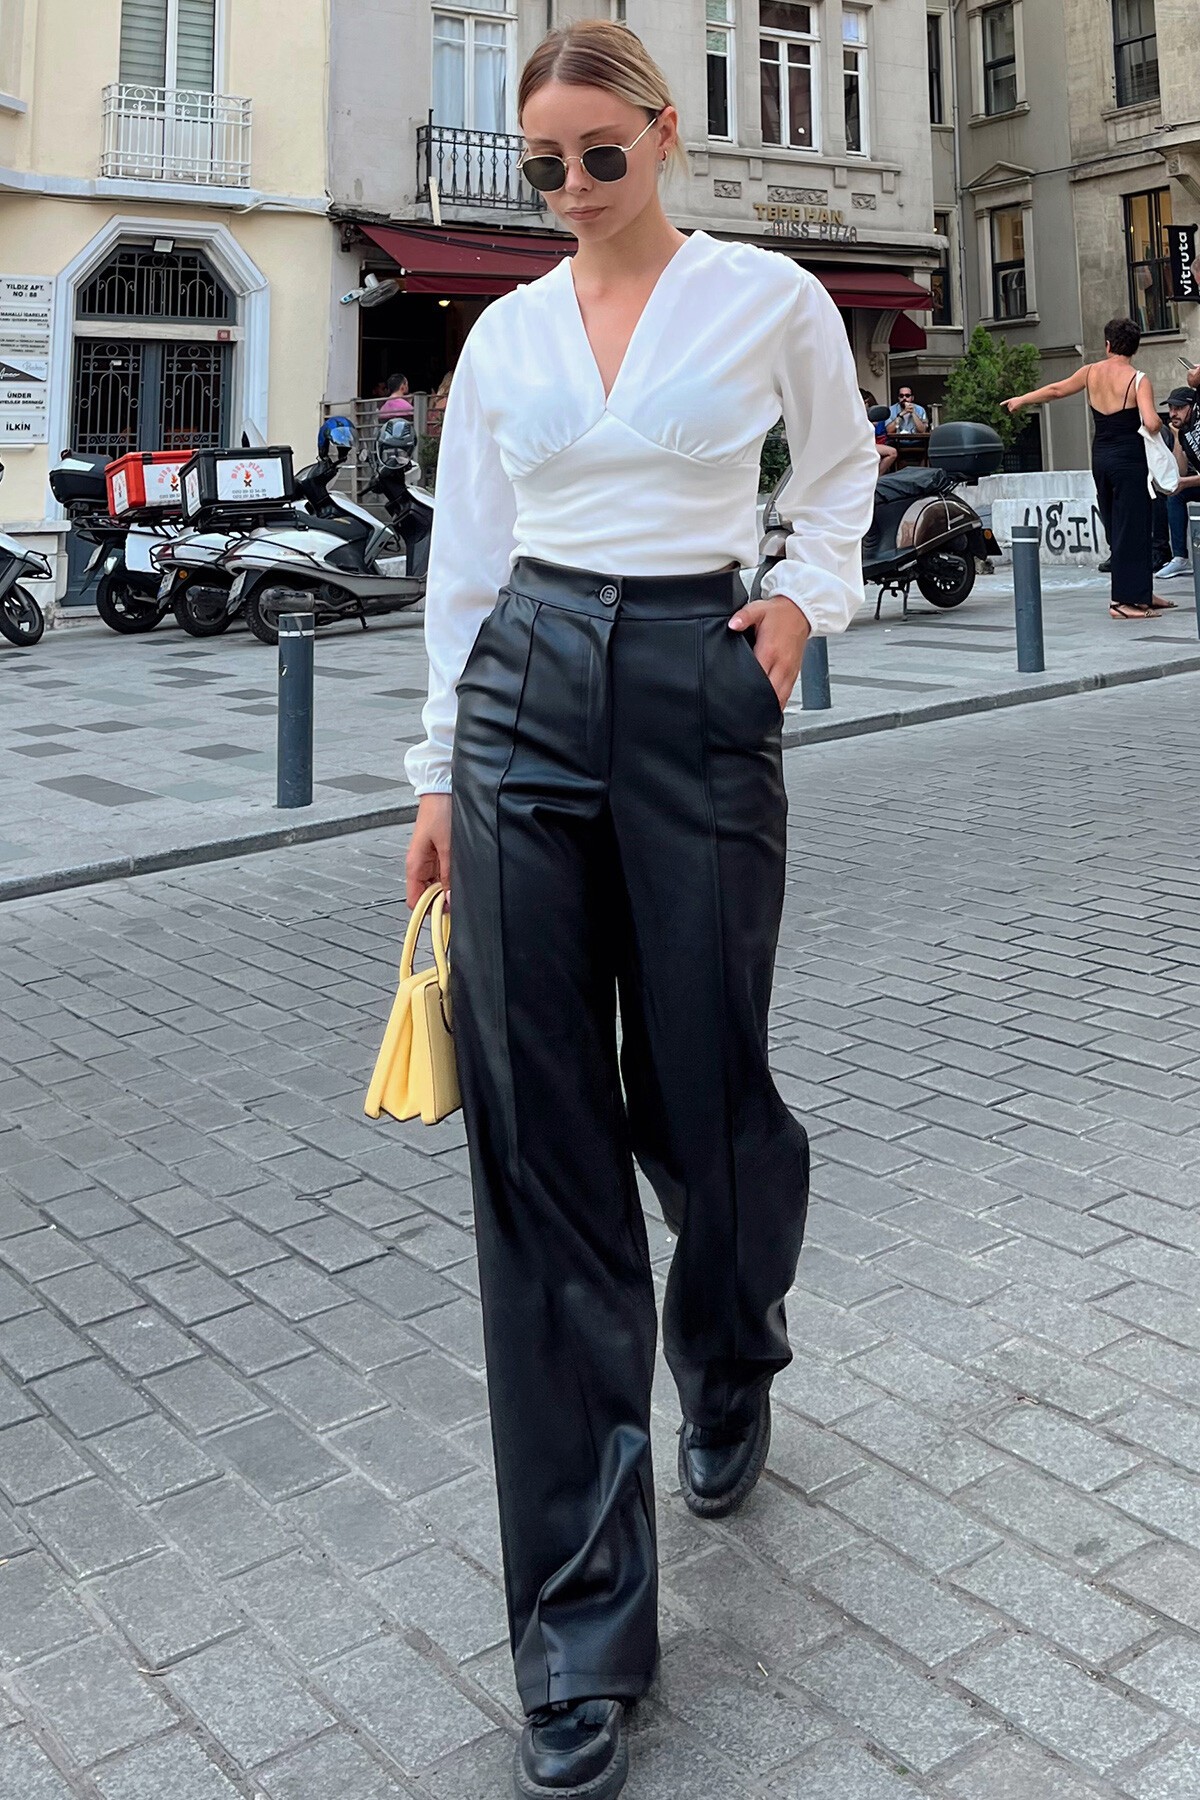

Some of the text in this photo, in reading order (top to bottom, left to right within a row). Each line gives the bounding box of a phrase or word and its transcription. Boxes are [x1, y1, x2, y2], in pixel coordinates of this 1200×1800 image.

[753, 202, 844, 226] TEPE HAN
[773, 219, 858, 243] MISS PIZZA
[1179, 232, 1192, 295] vitruta
[6, 422, 31, 431] İLKİN
